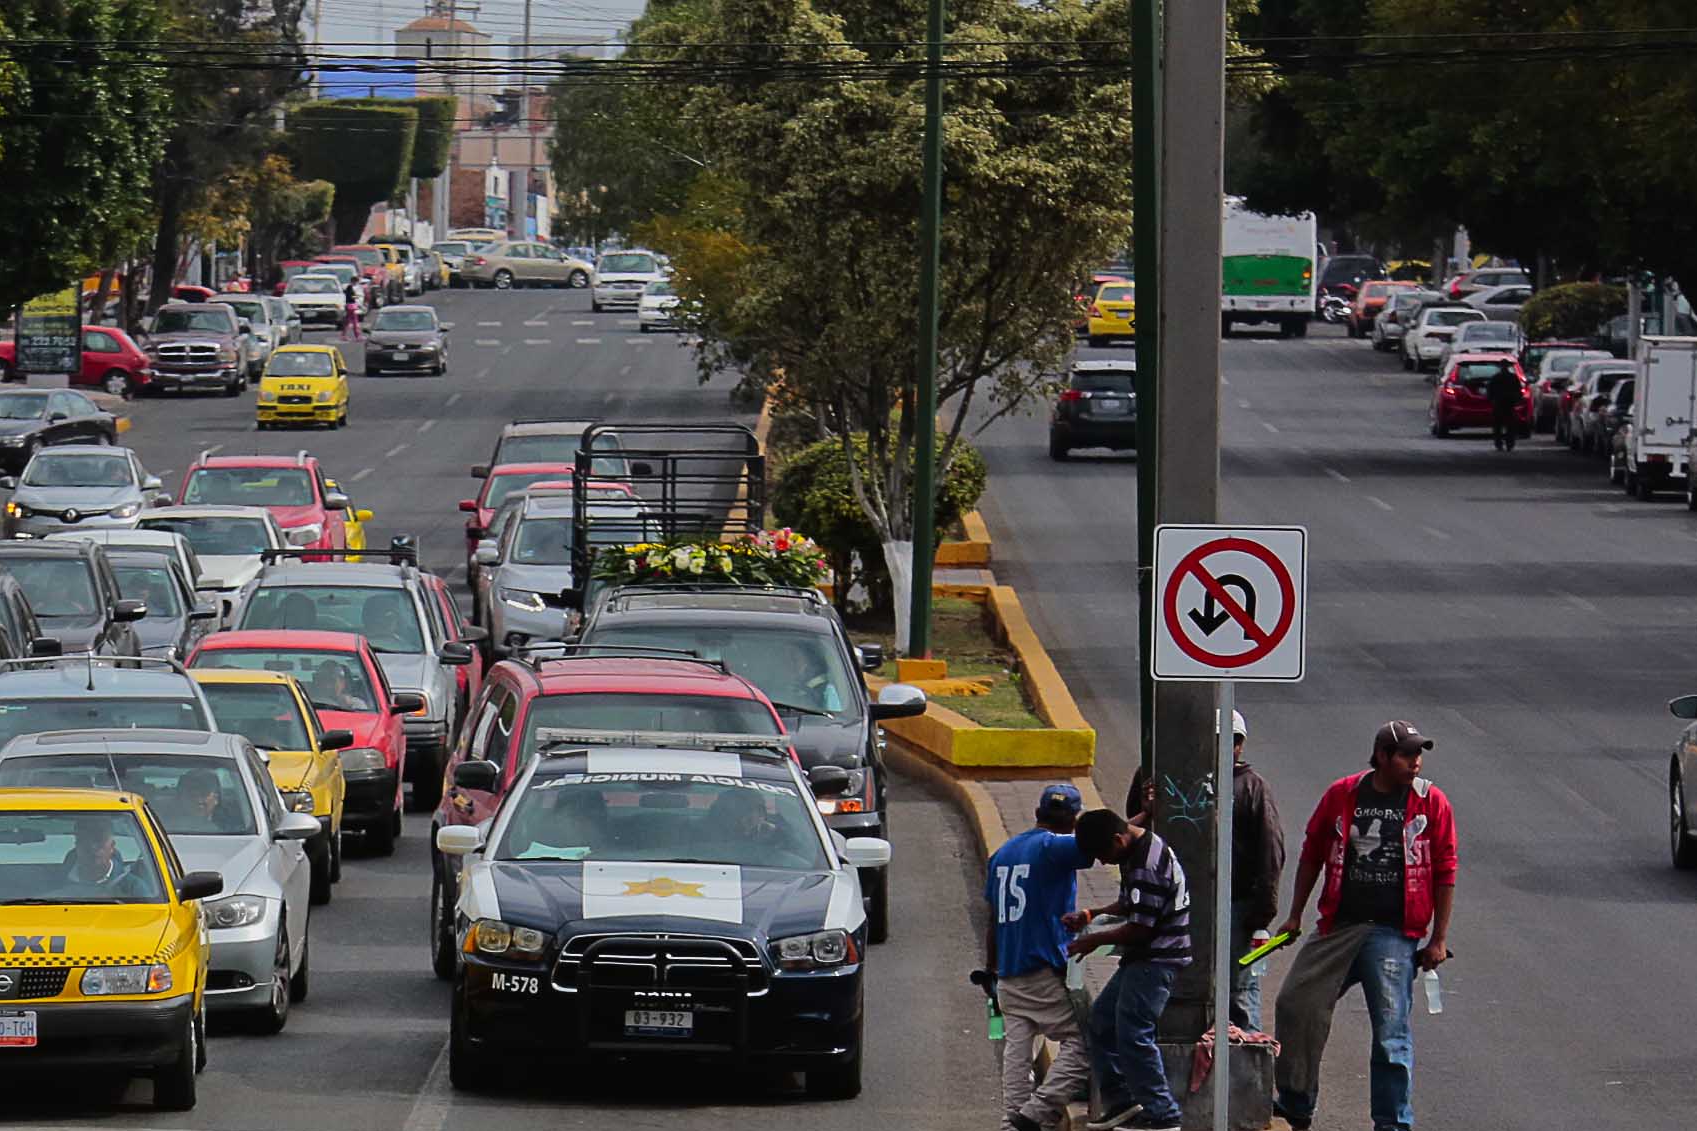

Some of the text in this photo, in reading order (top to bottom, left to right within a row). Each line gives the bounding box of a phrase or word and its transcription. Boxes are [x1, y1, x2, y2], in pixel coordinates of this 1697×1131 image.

[279, 383, 312, 391] TAXI
[996, 863, 1030, 924] 15
[492, 973, 540, 994] M-578
[633, 1012, 685, 1026] 03-932
